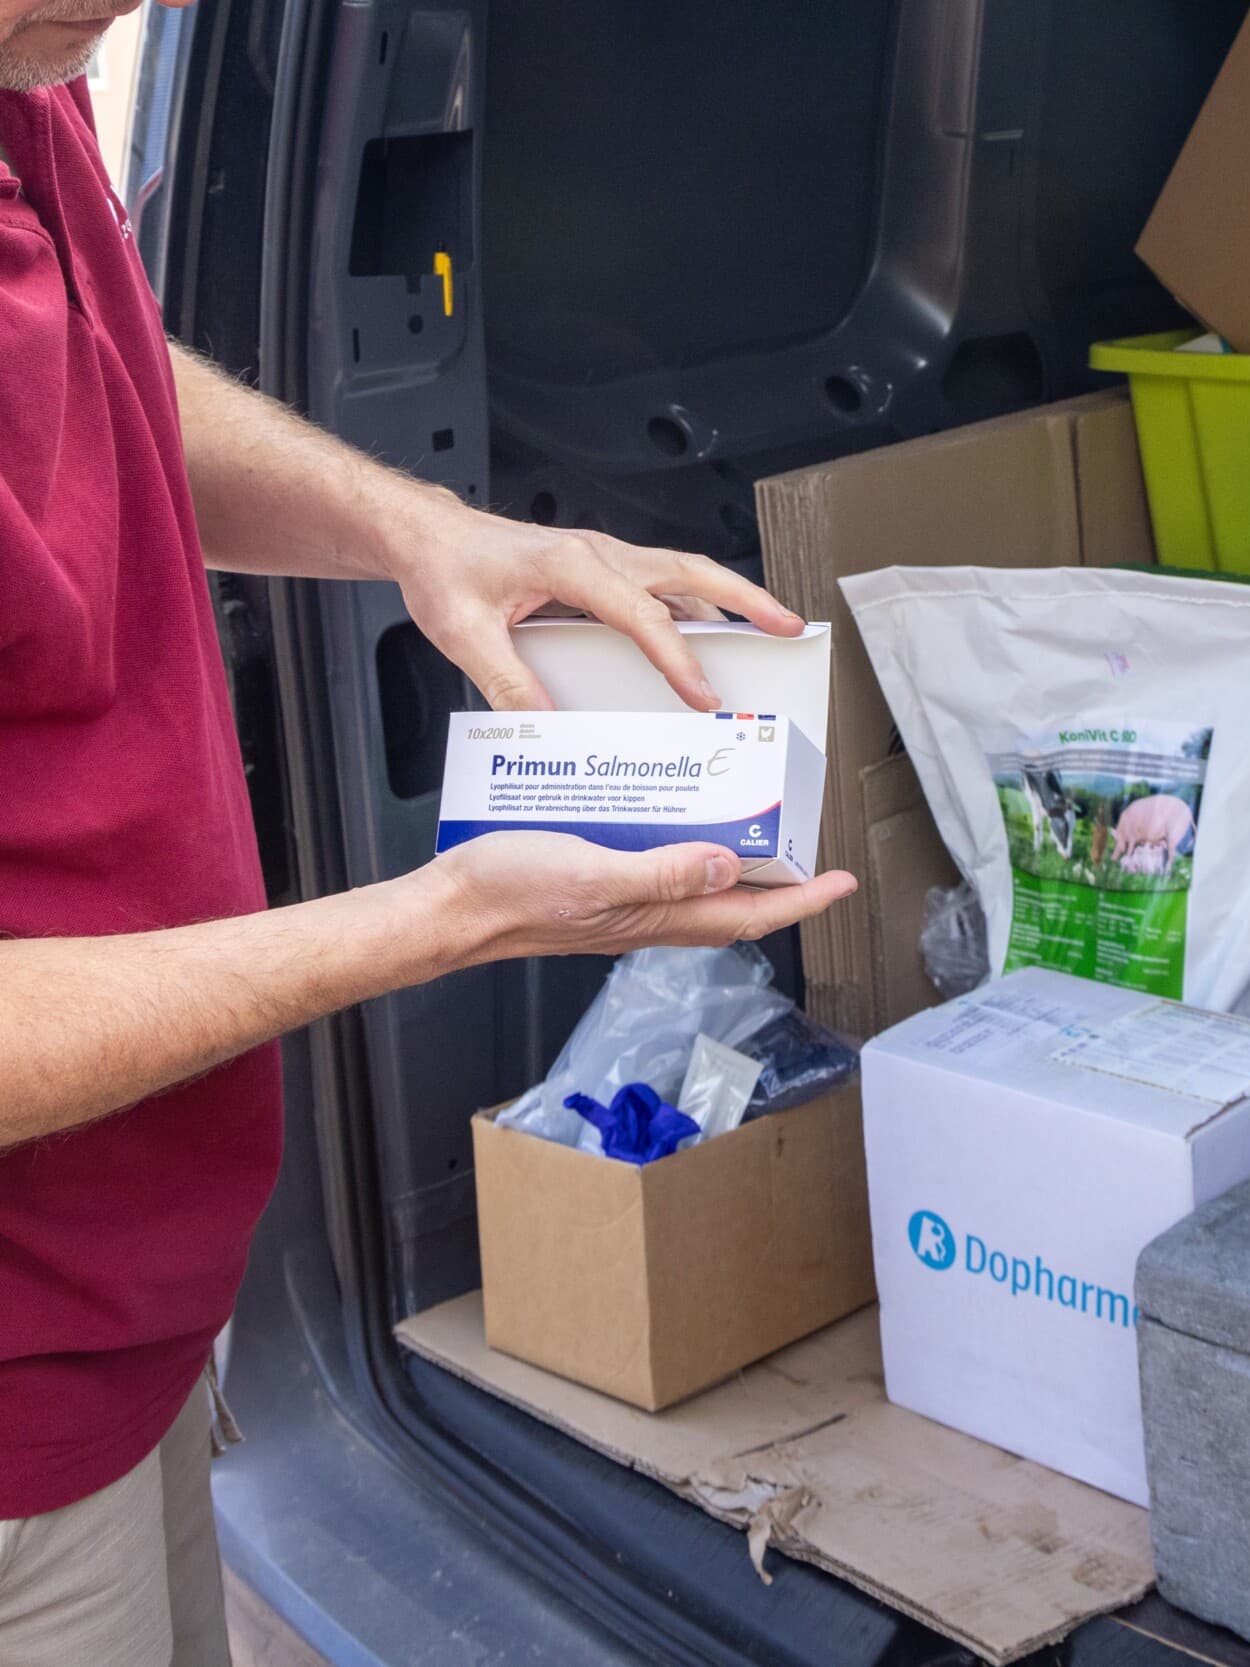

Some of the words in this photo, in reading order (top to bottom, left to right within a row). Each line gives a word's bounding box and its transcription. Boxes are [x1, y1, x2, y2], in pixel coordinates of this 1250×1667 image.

[467, 727, 515, 740] 10x2000
[491, 754, 576, 776] Primun
[584, 755, 702, 777] Salmonella
[706, 747, 737, 777] E
[490, 783, 524, 791] Lyophilisat
[525, 784, 540, 792] pour
[541, 783, 587, 791] administration
[675, 784, 699, 792] poulets
[538, 794, 562, 802] gebruik
[623, 795, 645, 803] kippen
[488, 804, 522, 812] Lyophilisat
[535, 804, 581, 813] Verabreichung
[663, 805, 687, 813] Hühner
[748, 824, 762, 838] C
